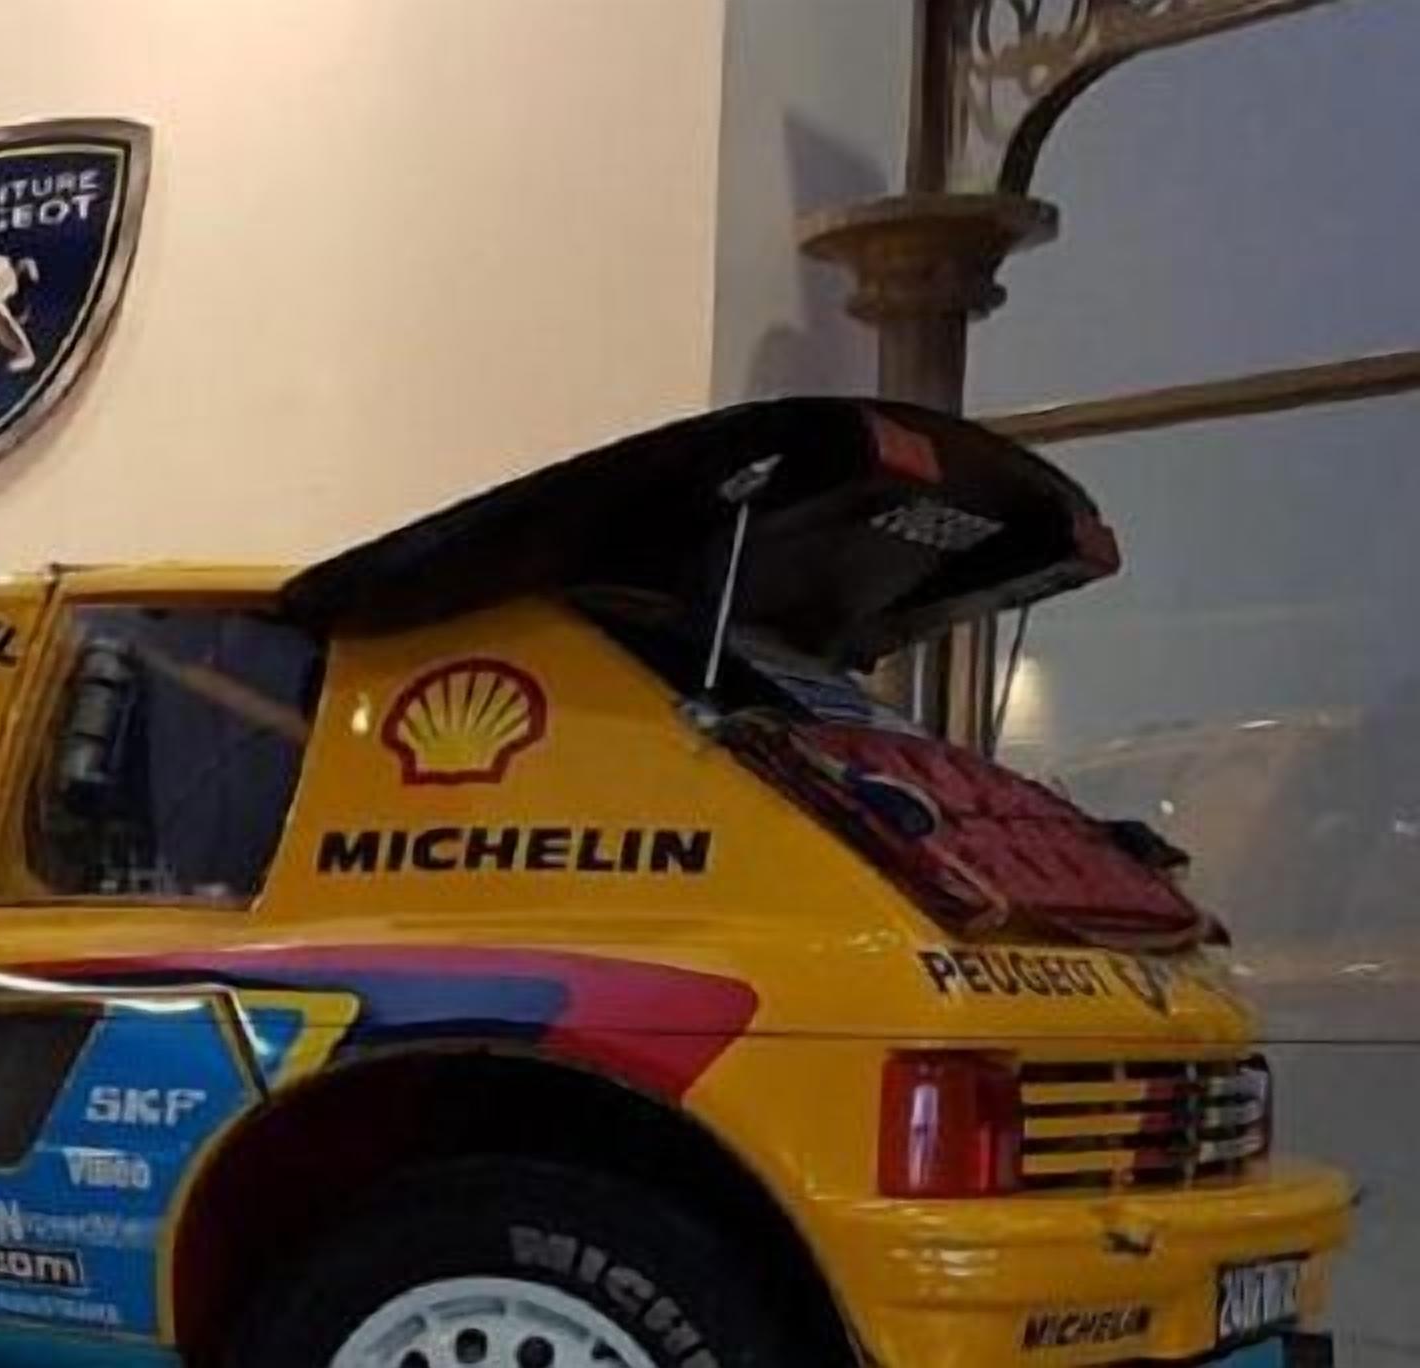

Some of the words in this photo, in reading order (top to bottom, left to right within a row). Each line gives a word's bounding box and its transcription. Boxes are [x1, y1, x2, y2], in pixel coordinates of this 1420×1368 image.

[317, 826, 712, 874] MICHELIN
[917, 950, 1111, 997] PEUGEOT
[86, 1085, 207, 1127] SKF
